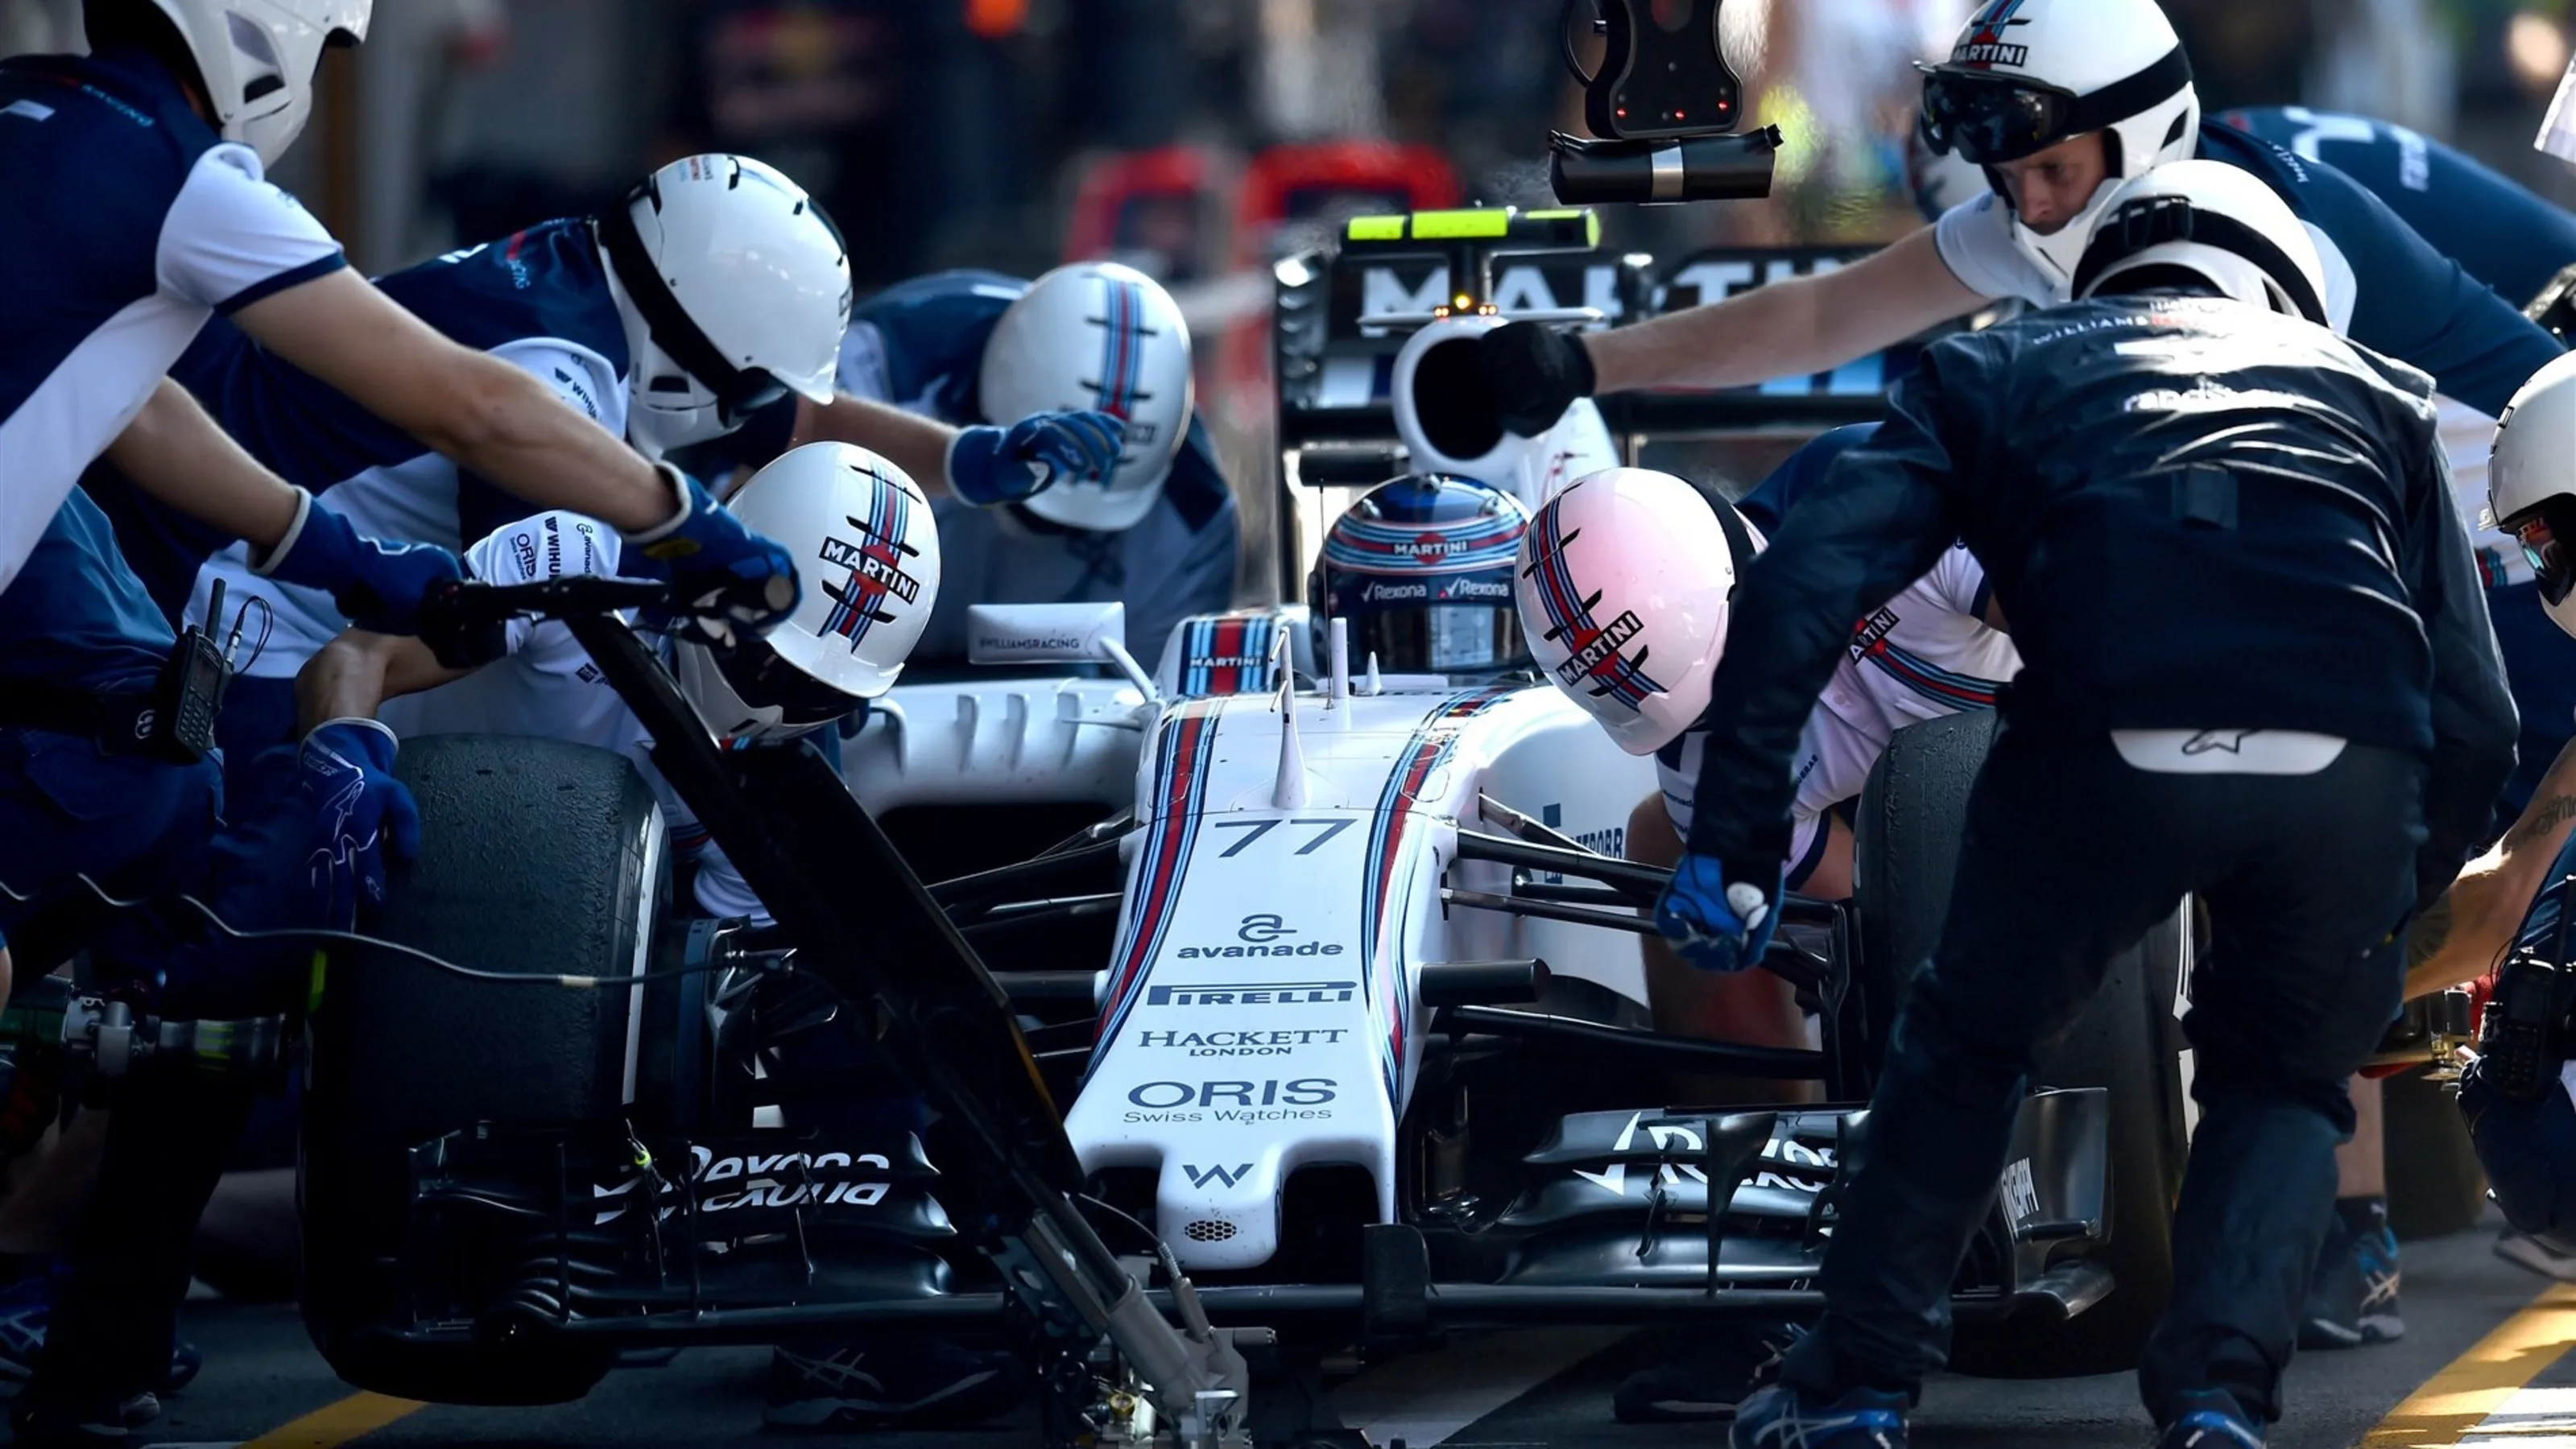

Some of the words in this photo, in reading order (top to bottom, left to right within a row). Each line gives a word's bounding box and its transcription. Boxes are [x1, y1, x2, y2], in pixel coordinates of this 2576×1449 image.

[583, 534, 593, 574] avanad
[1394, 541, 1467, 555] MARTINI
[824, 540, 917, 601] MARTINI
[1375, 582, 1427, 600] Rexona
[1460, 577, 1509, 597] Rexona
[1850, 607, 1896, 659] ARTINI
[1559, 613, 1639, 683] MARTINI
[1191, 657, 1262, 667] MARTINI
[1214, 819, 1358, 858] 77
[1177, 941, 1344, 959] avanade
[1147, 981, 1358, 1005] PIRELLI
[1139, 1030, 1348, 1047] HACKETT
[1189, 1046, 1292, 1056] LONDON
[1127, 1078, 1338, 1108] ORIS
[1123, 1110, 1202, 1123] Swiss
[1214, 1108, 1333, 1122] Watches
